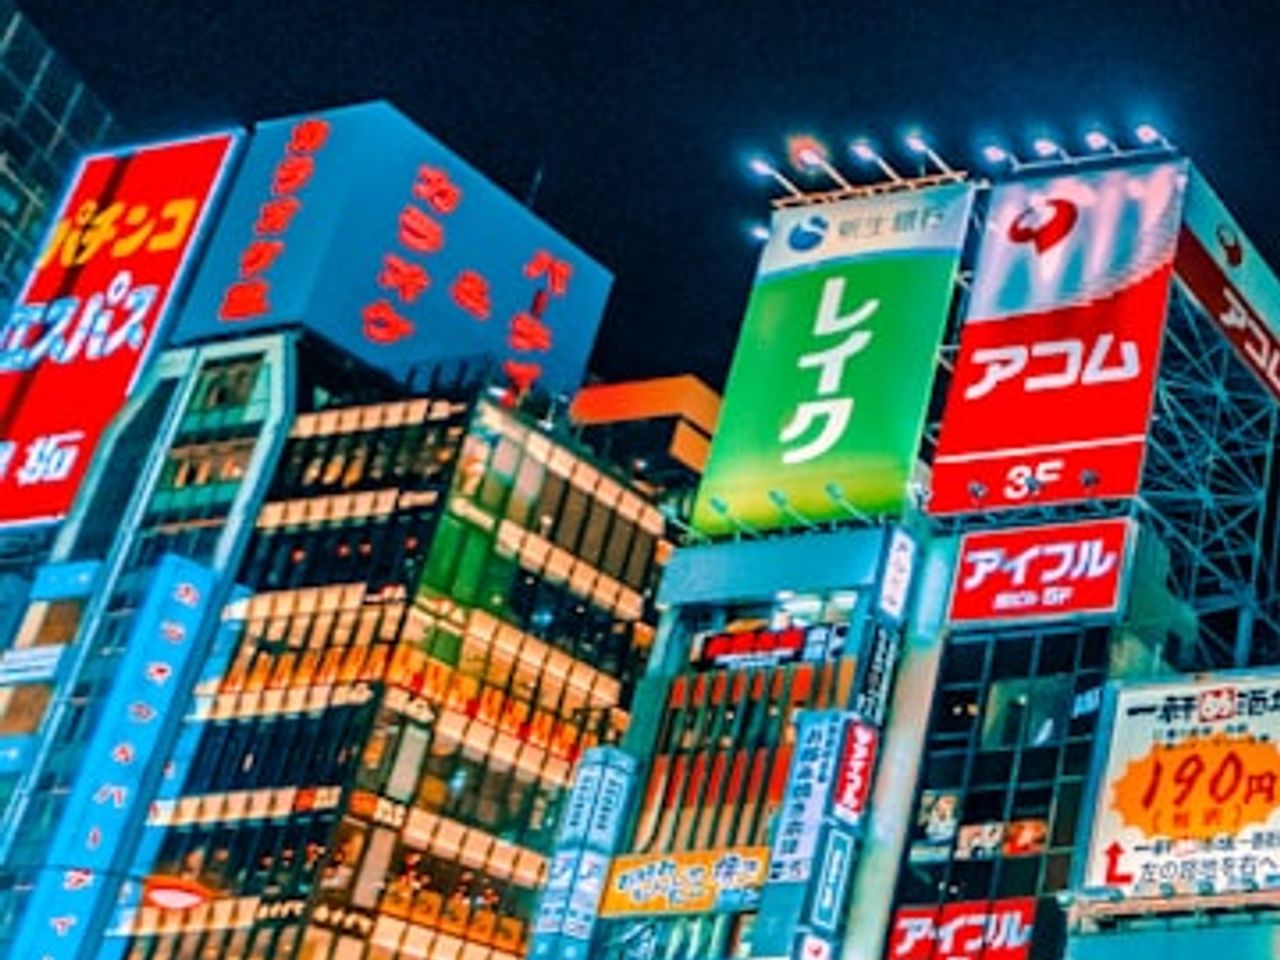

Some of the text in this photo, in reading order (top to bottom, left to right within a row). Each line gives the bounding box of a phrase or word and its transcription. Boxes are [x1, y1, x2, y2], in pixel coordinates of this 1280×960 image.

[779, 276, 880, 465] レイク
[964, 334, 1142, 400] アコム
[1003, 460, 1065, 499] 3F
[963, 540, 1118, 592] アイフル
[1140, 750, 1279, 810] 190円
[895, 909, 1034, 955] アイフル
